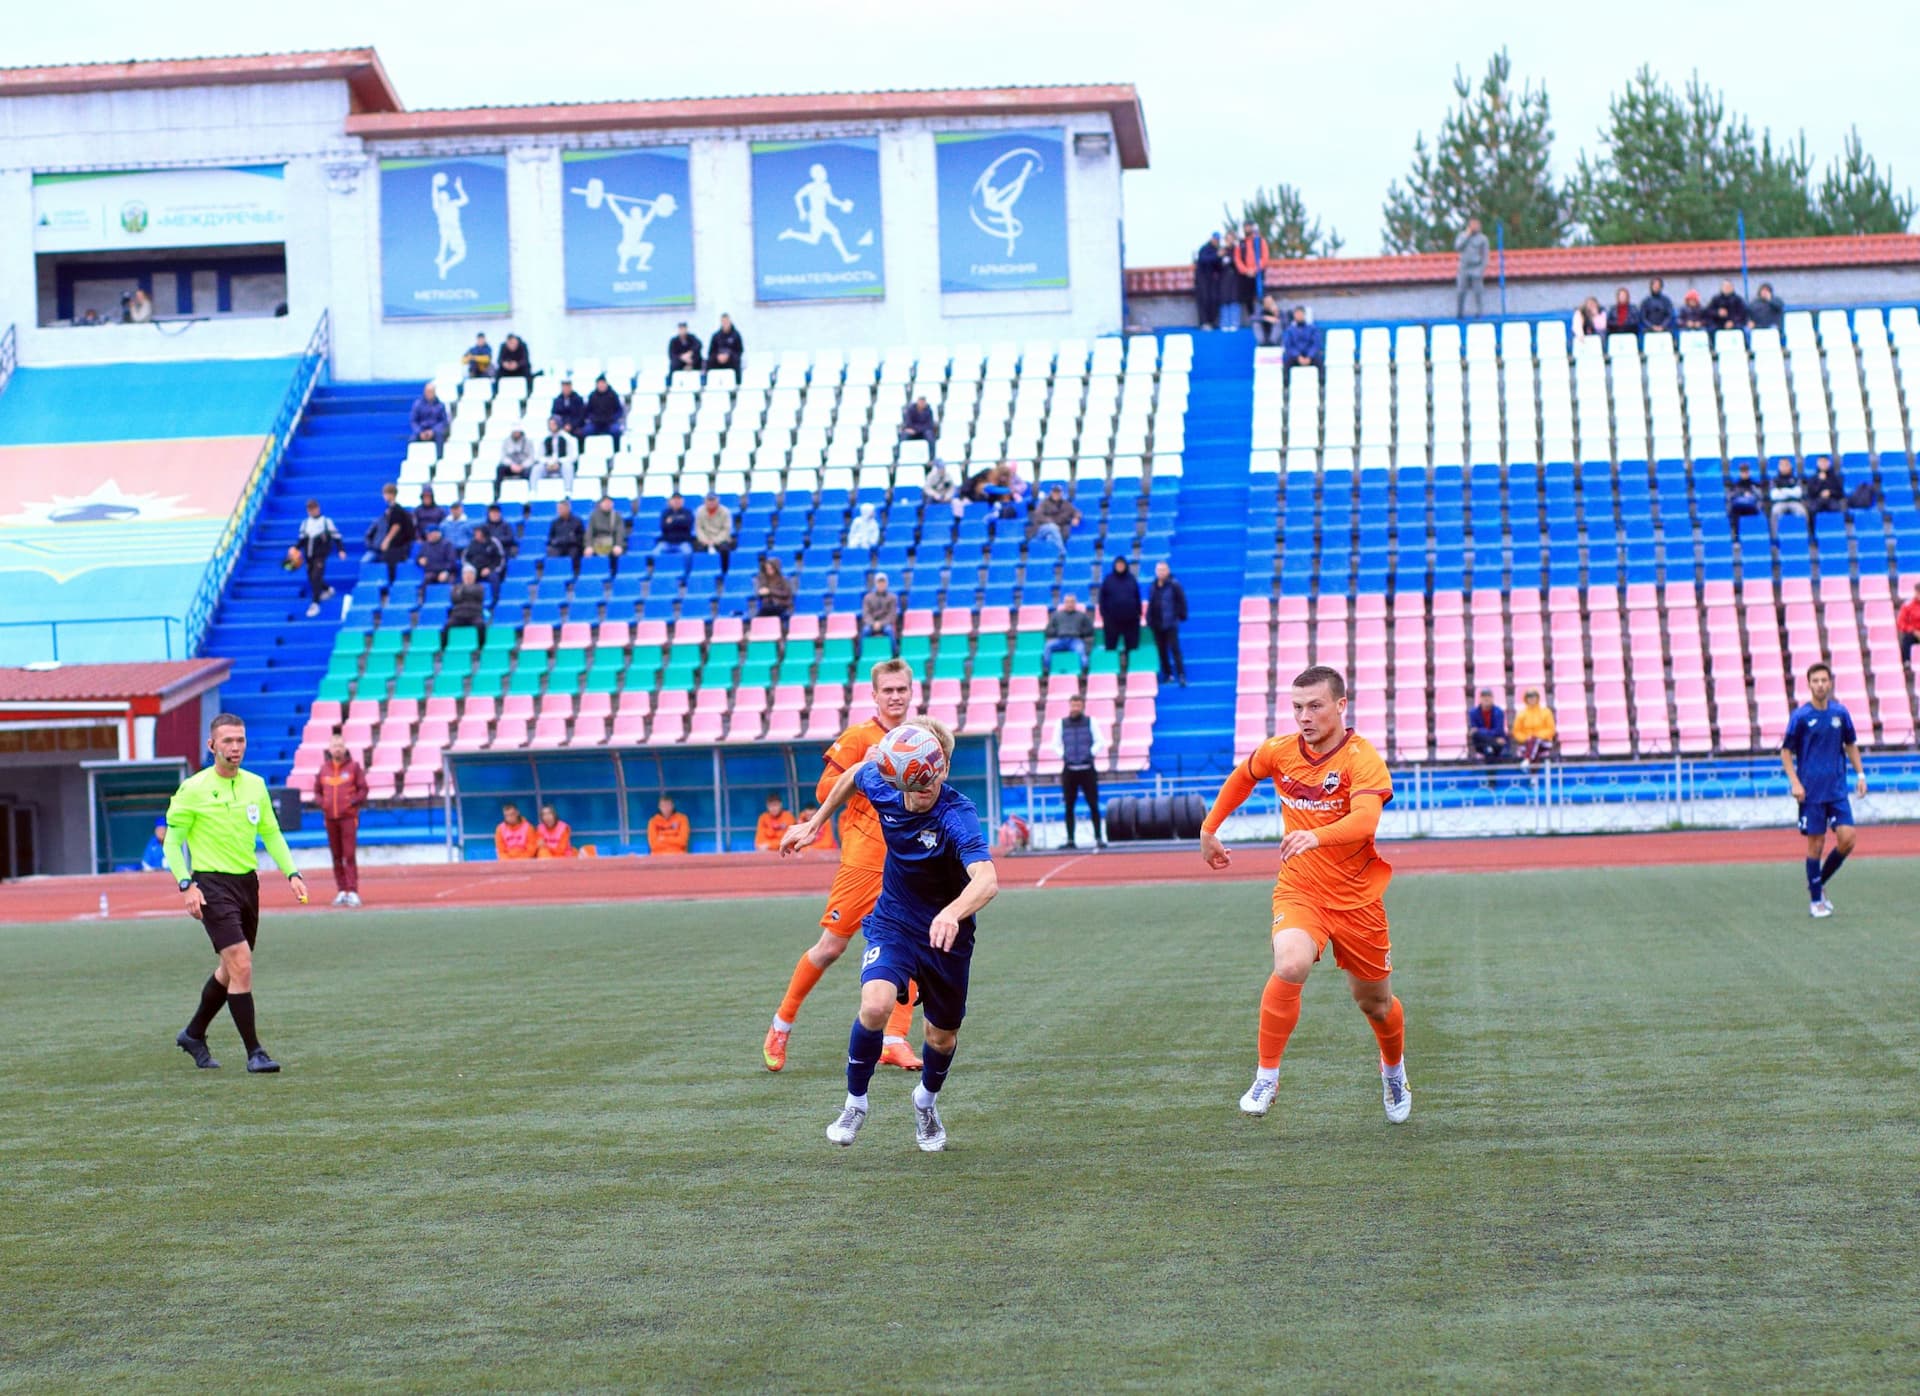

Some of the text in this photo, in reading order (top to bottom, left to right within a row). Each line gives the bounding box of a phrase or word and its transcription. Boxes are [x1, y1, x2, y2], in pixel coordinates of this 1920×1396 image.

[970, 262, 1039, 275] ГАРМОНИЯ
[764, 271, 878, 285] ВНИМАТЕЛЬНОСТЬ
[612, 280, 649, 293] ВОЛЯ
[414, 289, 479, 301] МЕТКОСТЬ
[862, 946, 881, 970] 19
